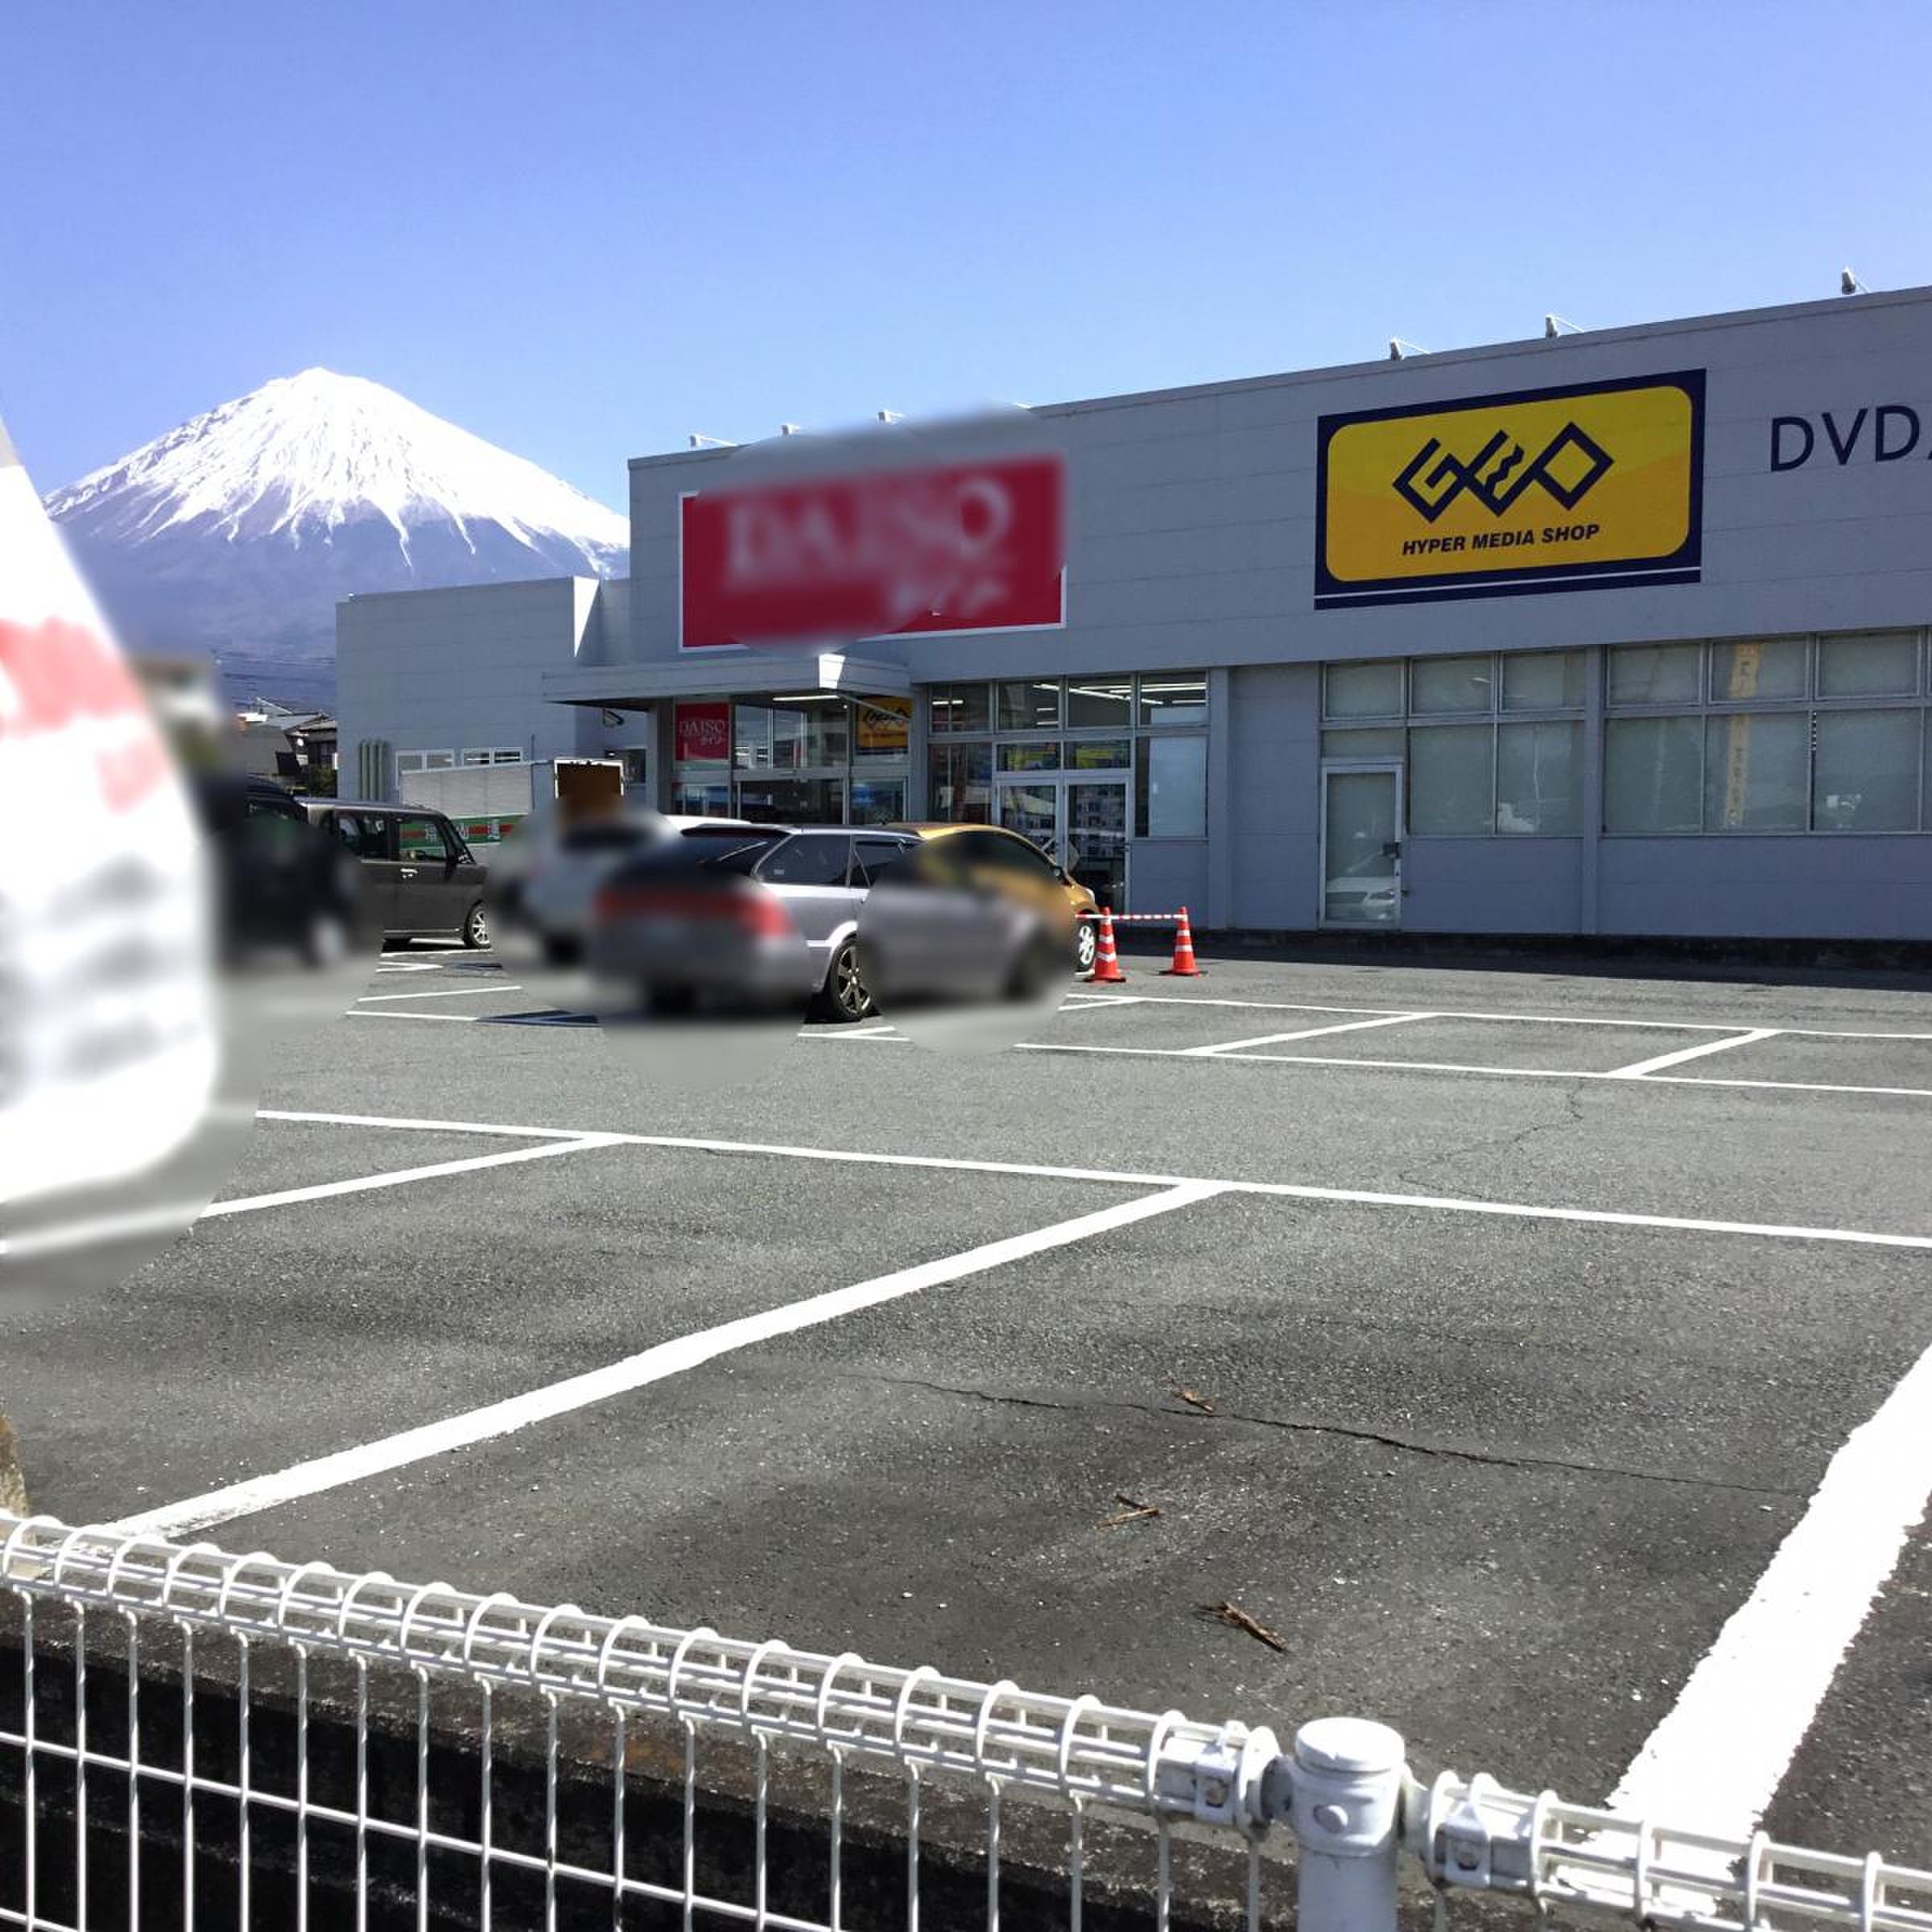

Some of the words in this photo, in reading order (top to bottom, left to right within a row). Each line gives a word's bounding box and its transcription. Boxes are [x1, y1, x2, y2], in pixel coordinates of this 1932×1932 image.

[1771, 405, 1932, 472] DVD
[1392, 421, 1614, 523] GEO
[1402, 537, 1466, 555] HYPER
[1472, 530, 1534, 549] MEDIA
[1542, 524, 1600, 543] SHOP
[679, 720, 726, 736] DAISO
